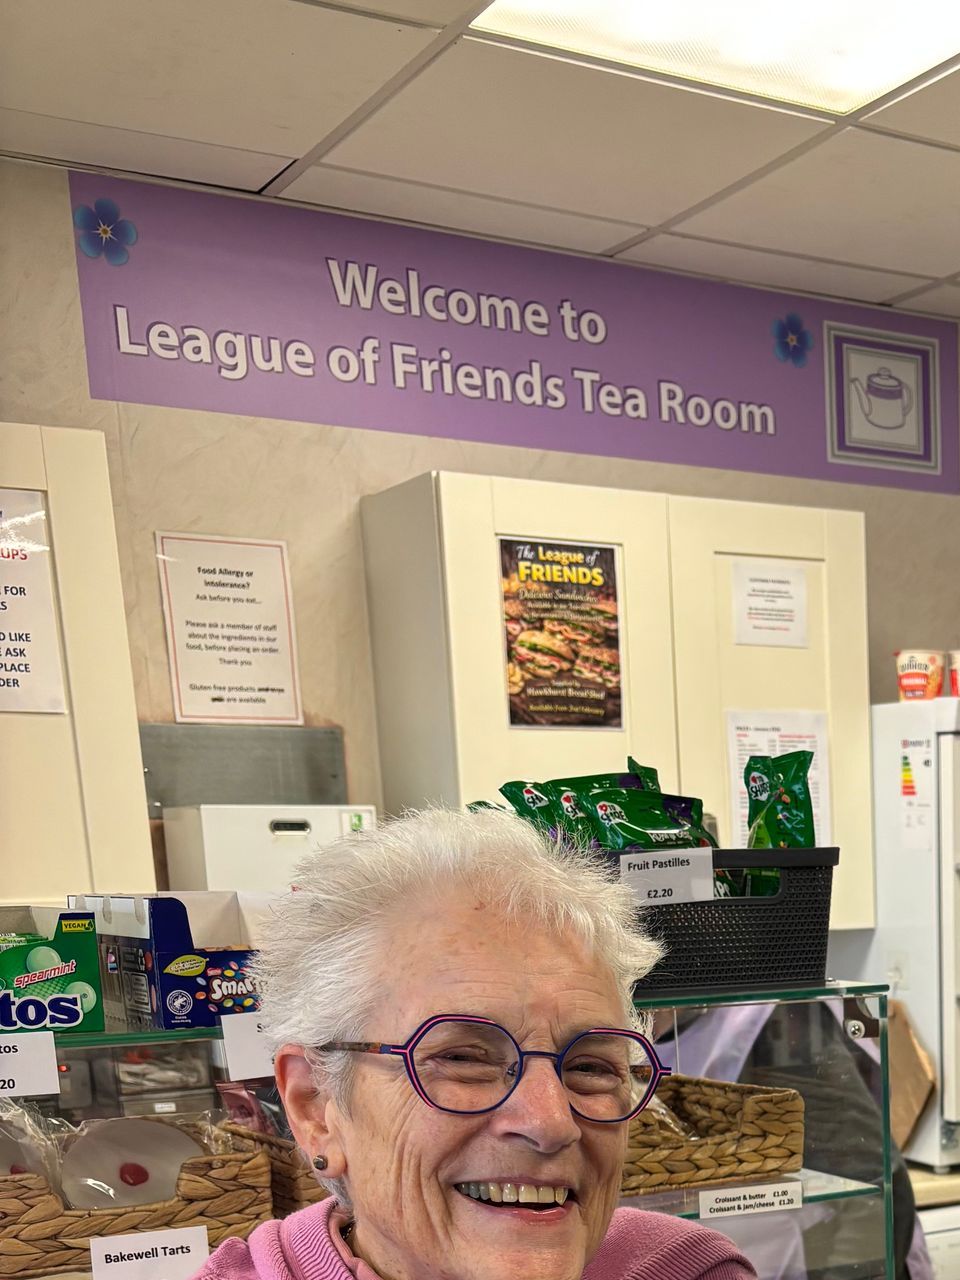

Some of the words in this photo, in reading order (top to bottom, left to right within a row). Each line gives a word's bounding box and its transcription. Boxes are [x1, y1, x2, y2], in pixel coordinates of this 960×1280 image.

[326, 257, 549, 335] Welcome
[561, 303, 608, 345] to
[114, 305, 315, 381] League
[328, 337, 379, 386] of
[392, 343, 567, 409] Friends
[572, 368, 648, 419] Tea
[657, 380, 777, 435] Room
[0, 548, 28, 561] UPS
[516, 545, 535, 559] The
[538, 546, 585, 565] League
[586, 551, 600, 566] of
[197, 566, 217, 575] Food
[218, 567, 244, 578] Allergy
[518, 561, 604, 587] FRIENDS
[204, 579, 250, 589] Intolerance?
[4, 586, 26, 596] FOR
[208, 594, 231, 602] before
[185, 620, 207, 628] Please
[208, 621, 219, 629] ask
[225, 622, 253, 630] member
[254, 623, 262, 631] of
[262, 623, 277, 632] staff
[9, 632, 31, 643] LIKE
[188, 632, 207, 640] about
[208, 632, 219, 640] the
[220, 633, 257, 642] ingredients
[5, 648, 26, 657] ASK
[205, 643, 226, 652] before
[227, 645, 251, 653] placing
[0, 663, 31, 673] PLACE
[189, 683, 212, 691] Gluten
[627, 861, 650, 871] Fruit
[652, 857, 691, 869] Pastilles
[647, 888, 673, 898] £2.20
[63, 921, 87, 929] VEGAN
[14, 959, 76, 988] spearmint
[0, 990, 84, 1030] tos
[0, 1078, 16, 1090] 20
[715, 1194, 742, 1204] Croissant
[772, 1190, 789, 1198] £1.00
[709, 1205, 736, 1214] Croissant
[743, 1200, 775, 1211] jam/cheese
[778, 1198, 794, 1206] £1.20
[104, 1247, 159, 1264] Bakewell
[161, 1245, 191, 1256] Tarts
